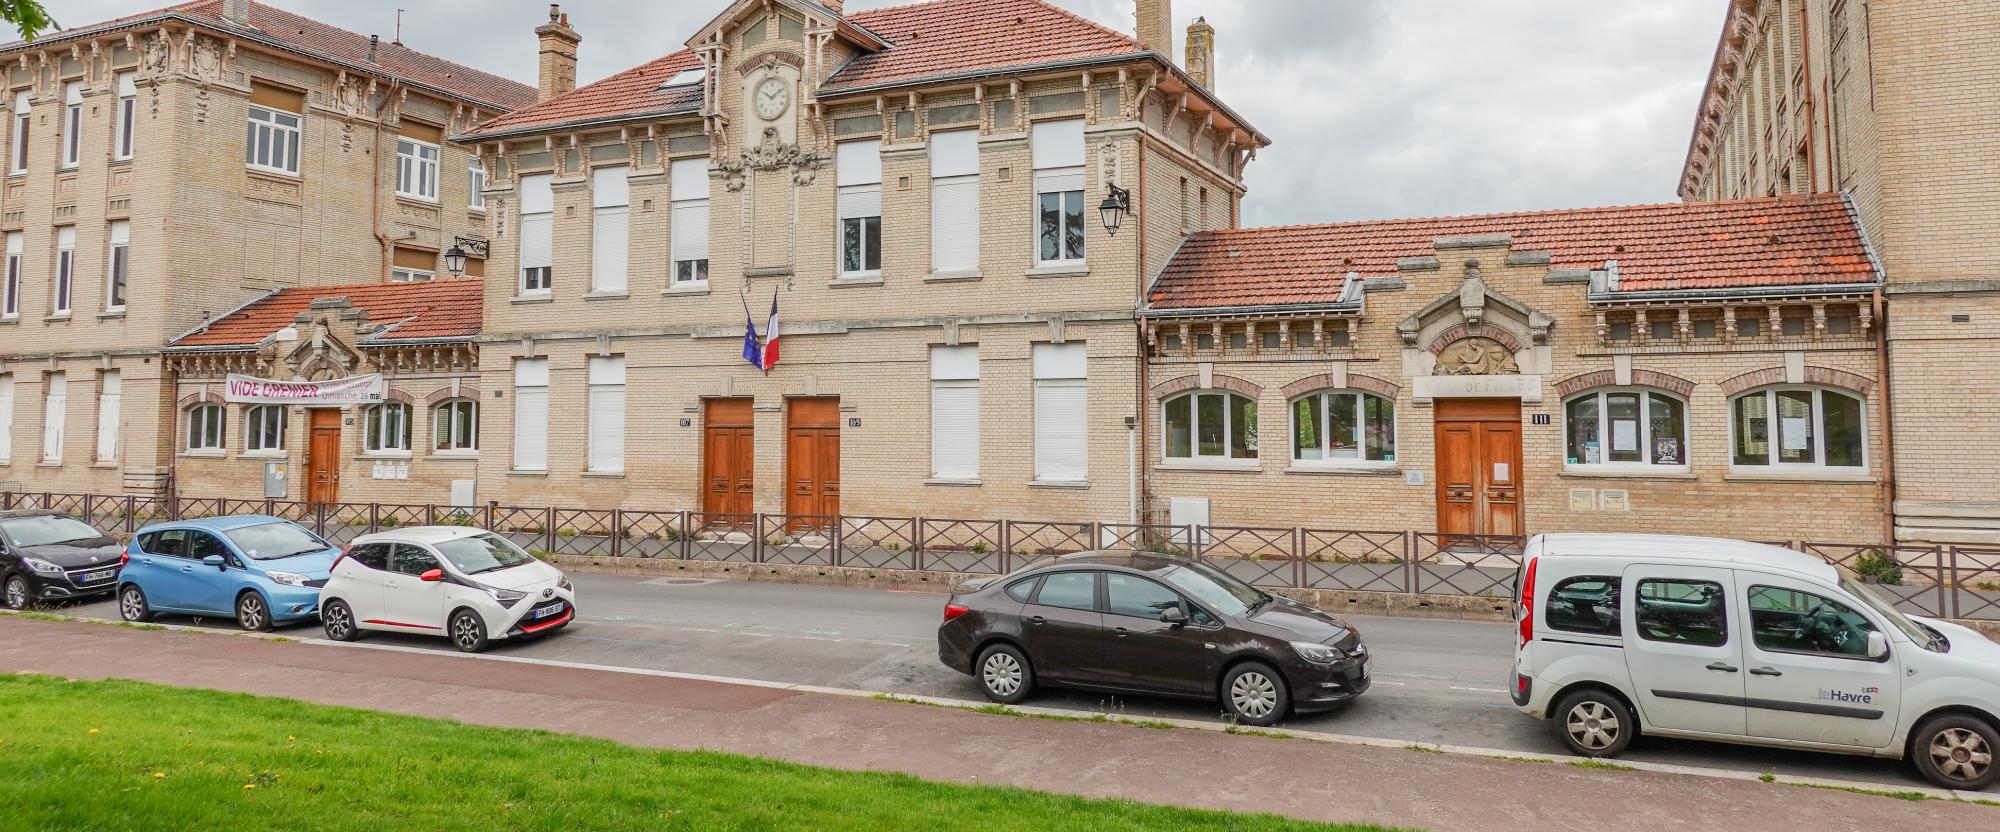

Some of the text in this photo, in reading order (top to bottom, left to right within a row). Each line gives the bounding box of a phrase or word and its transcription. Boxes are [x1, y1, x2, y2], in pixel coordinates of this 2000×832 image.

[230, 380, 319, 398] VIDE GRENIER
[1465, 381, 1481, 393] DE
[369, 391, 381, 400] mai
[1534, 414, 1548, 425] 111
